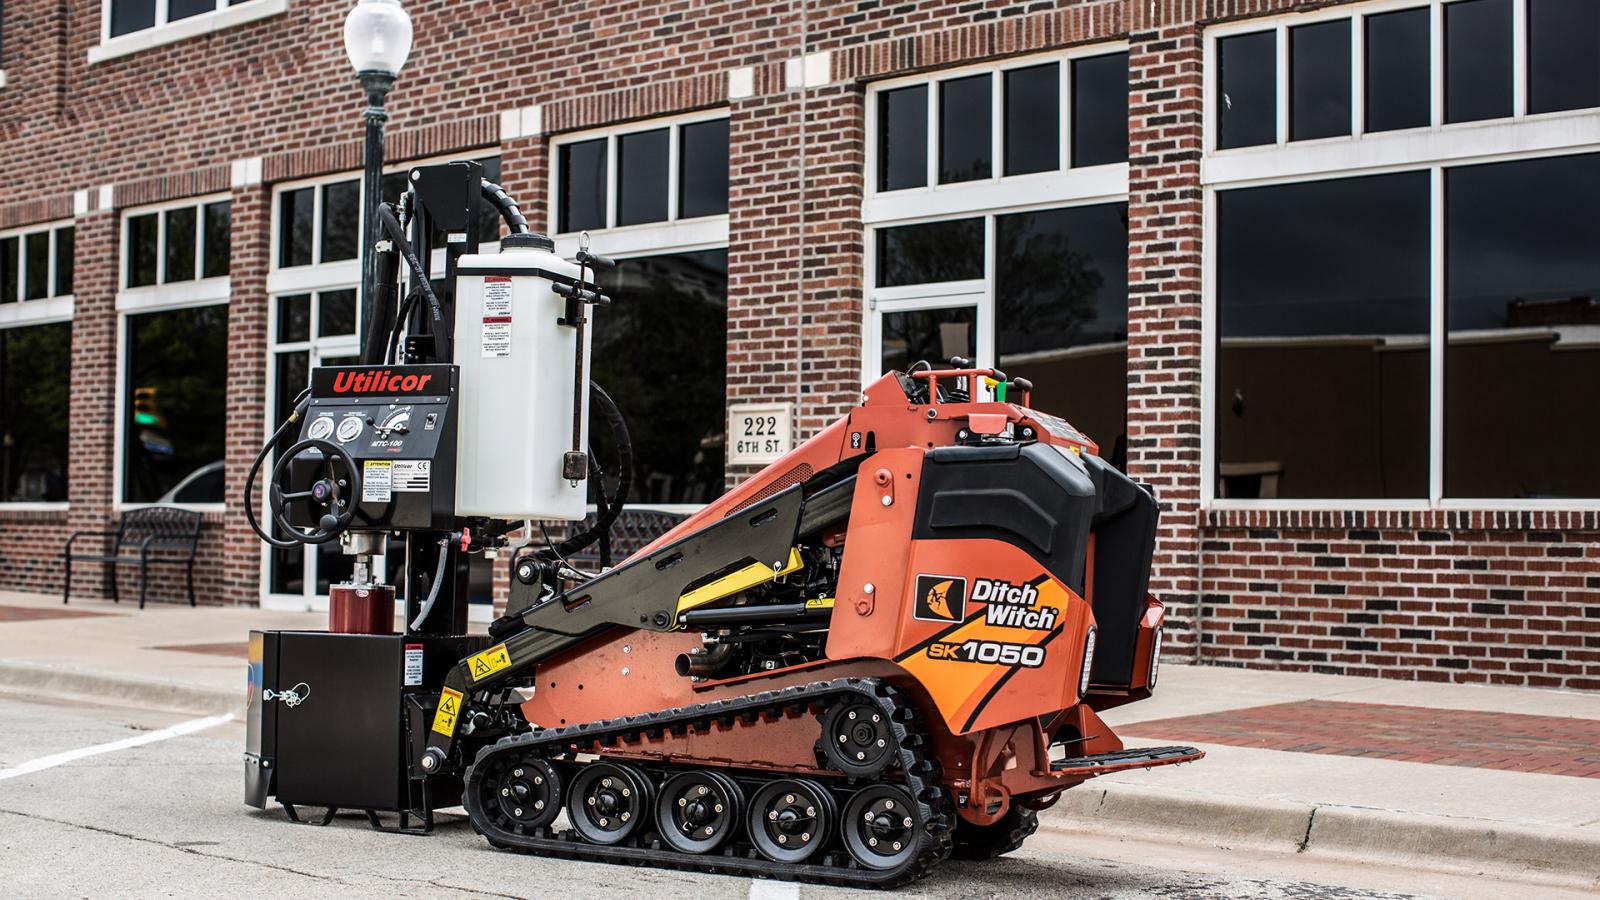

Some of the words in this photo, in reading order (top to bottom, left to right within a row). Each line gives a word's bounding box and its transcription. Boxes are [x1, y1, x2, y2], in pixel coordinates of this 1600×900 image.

[333, 370, 432, 393] Utilicor
[744, 416, 776, 436] 222
[371, 440, 403, 448] MTC-100
[737, 440, 759, 453] 6TH
[765, 439, 784, 453] ST.
[971, 580, 1037, 605] Ditch
